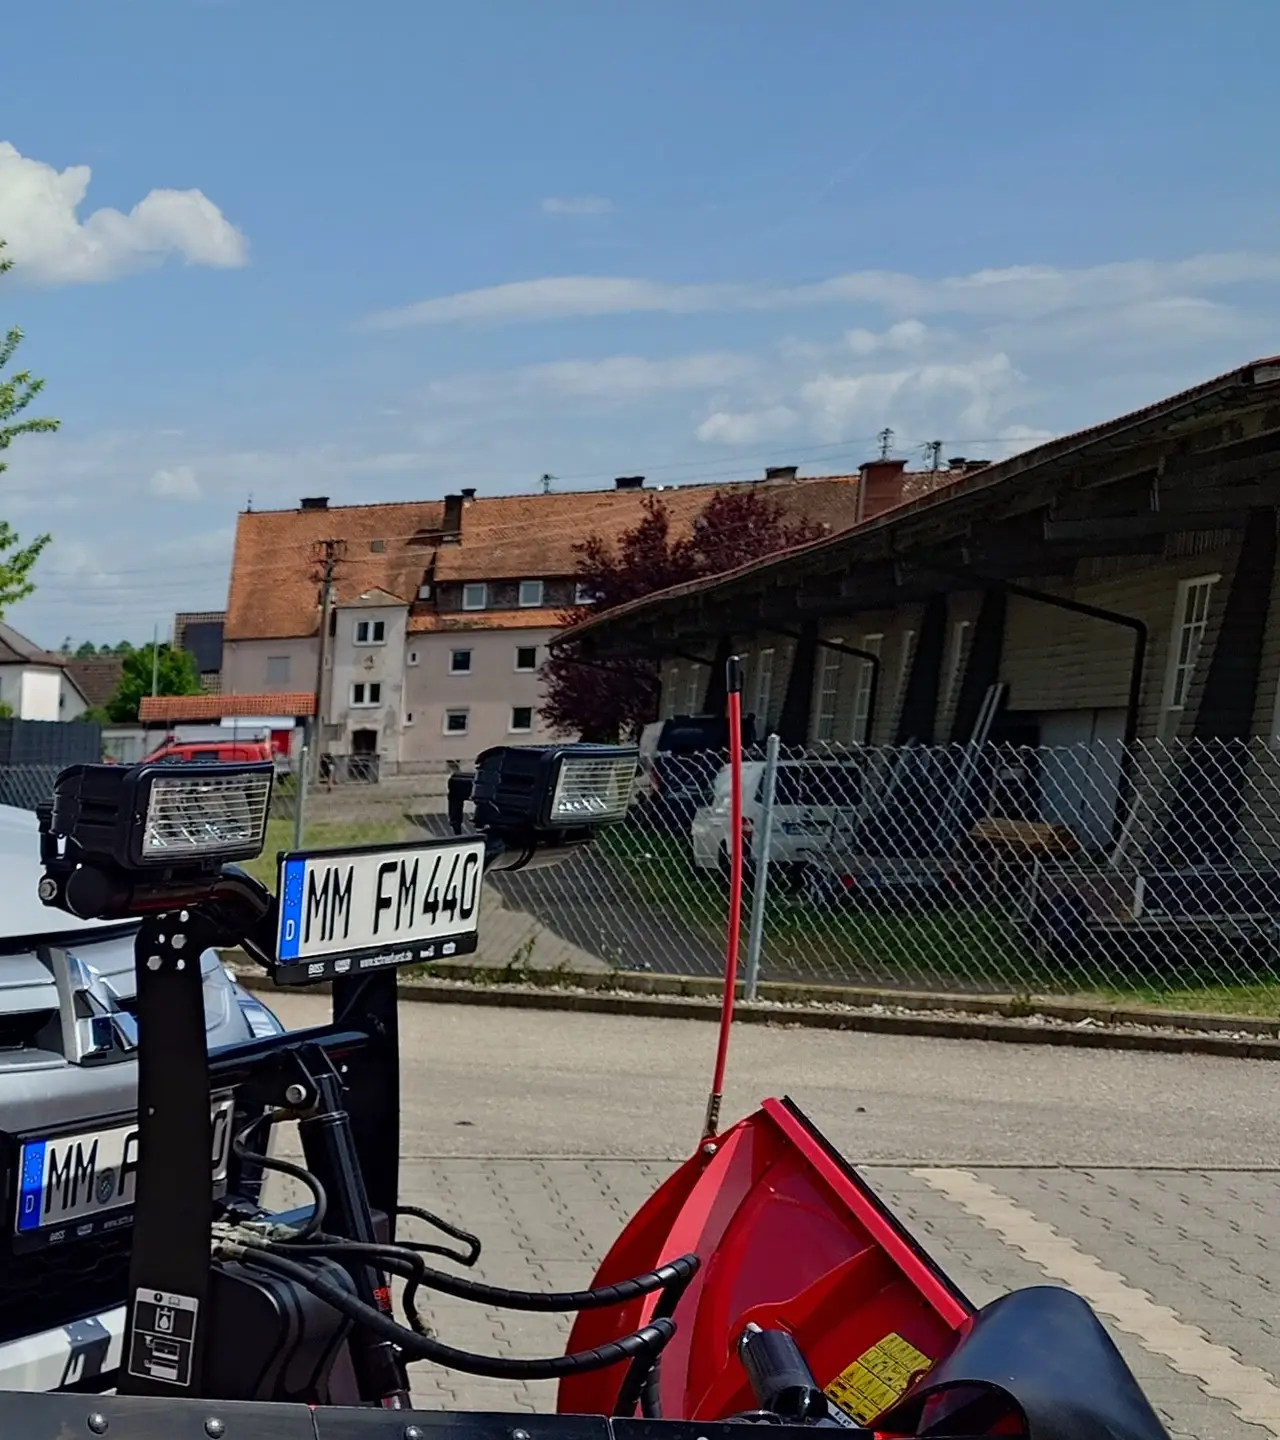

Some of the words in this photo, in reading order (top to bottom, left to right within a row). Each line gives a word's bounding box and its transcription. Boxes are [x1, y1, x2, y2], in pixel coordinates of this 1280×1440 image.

[286, 919, 296, 941] D
[304, 866, 354, 943] MM
[373, 858, 419, 935] FM
[422, 852, 478, 926] 440
[44, 1138, 99, 1214] MM
